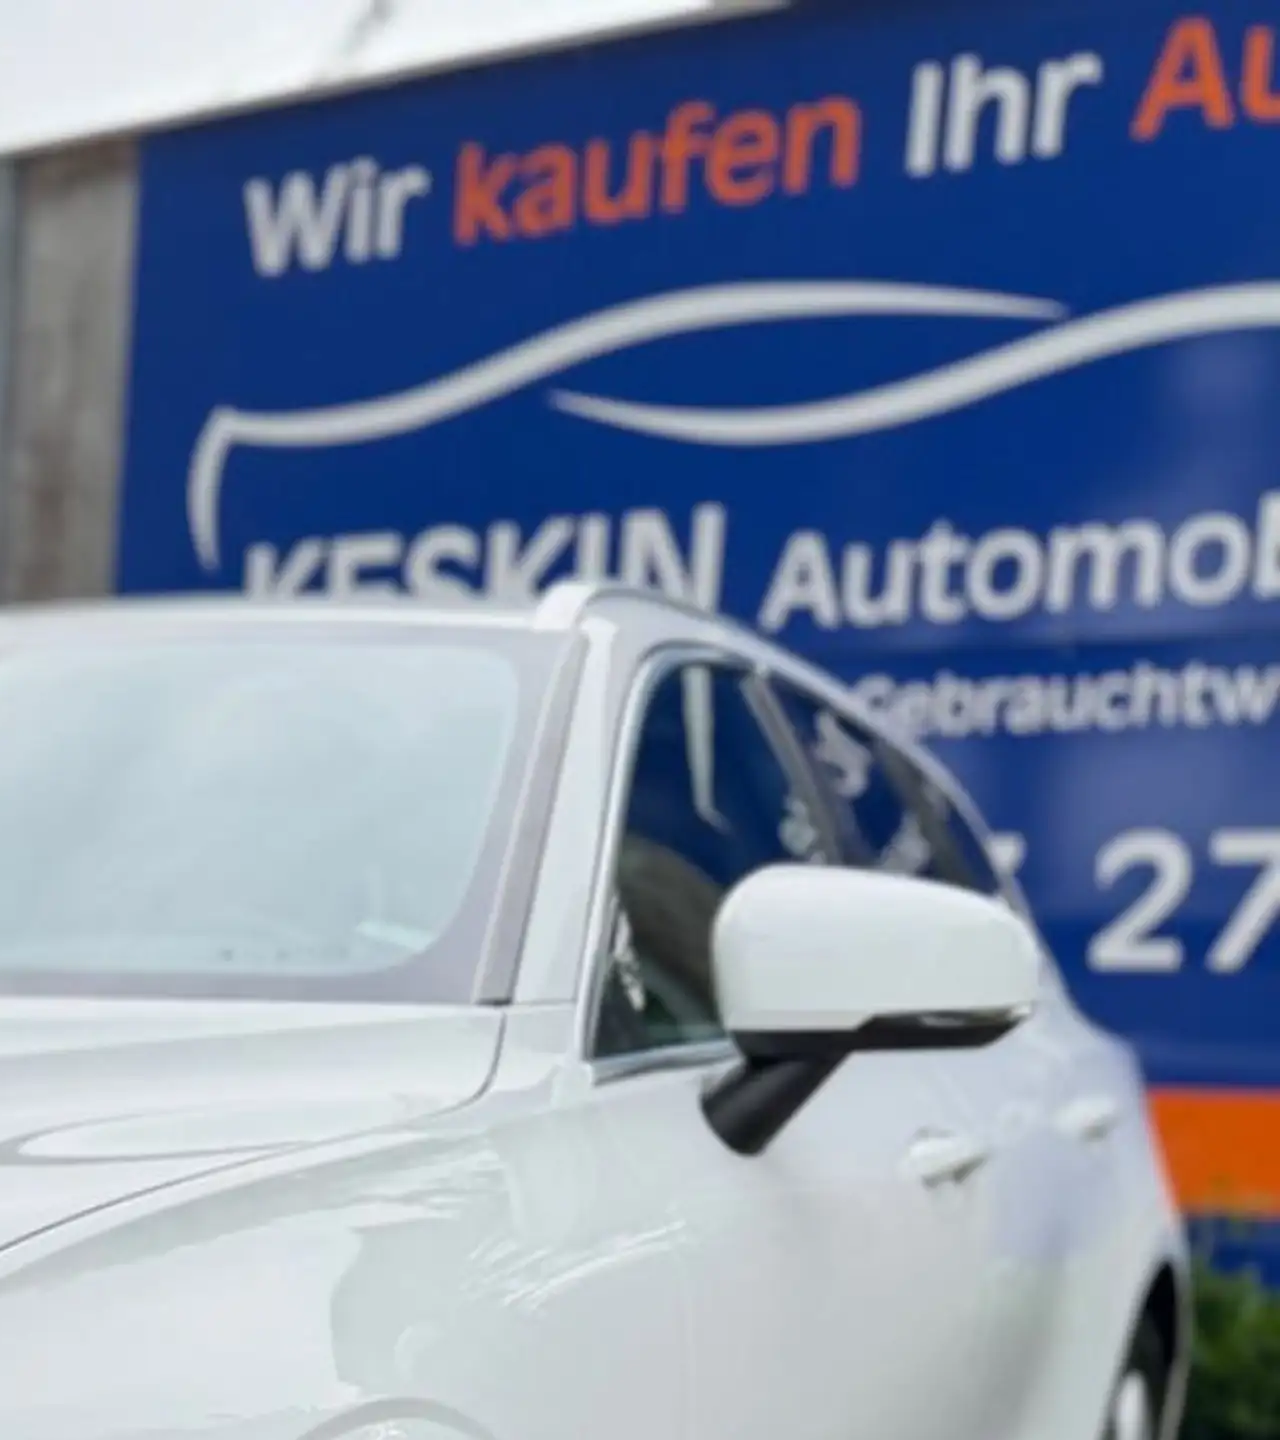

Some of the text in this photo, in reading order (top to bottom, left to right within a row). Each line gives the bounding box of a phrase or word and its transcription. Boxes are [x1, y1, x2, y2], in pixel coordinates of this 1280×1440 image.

[242, 157, 430, 278] Wir
[452, 96, 863, 246] kaufen
[904, 52, 1103, 176] Ihr
